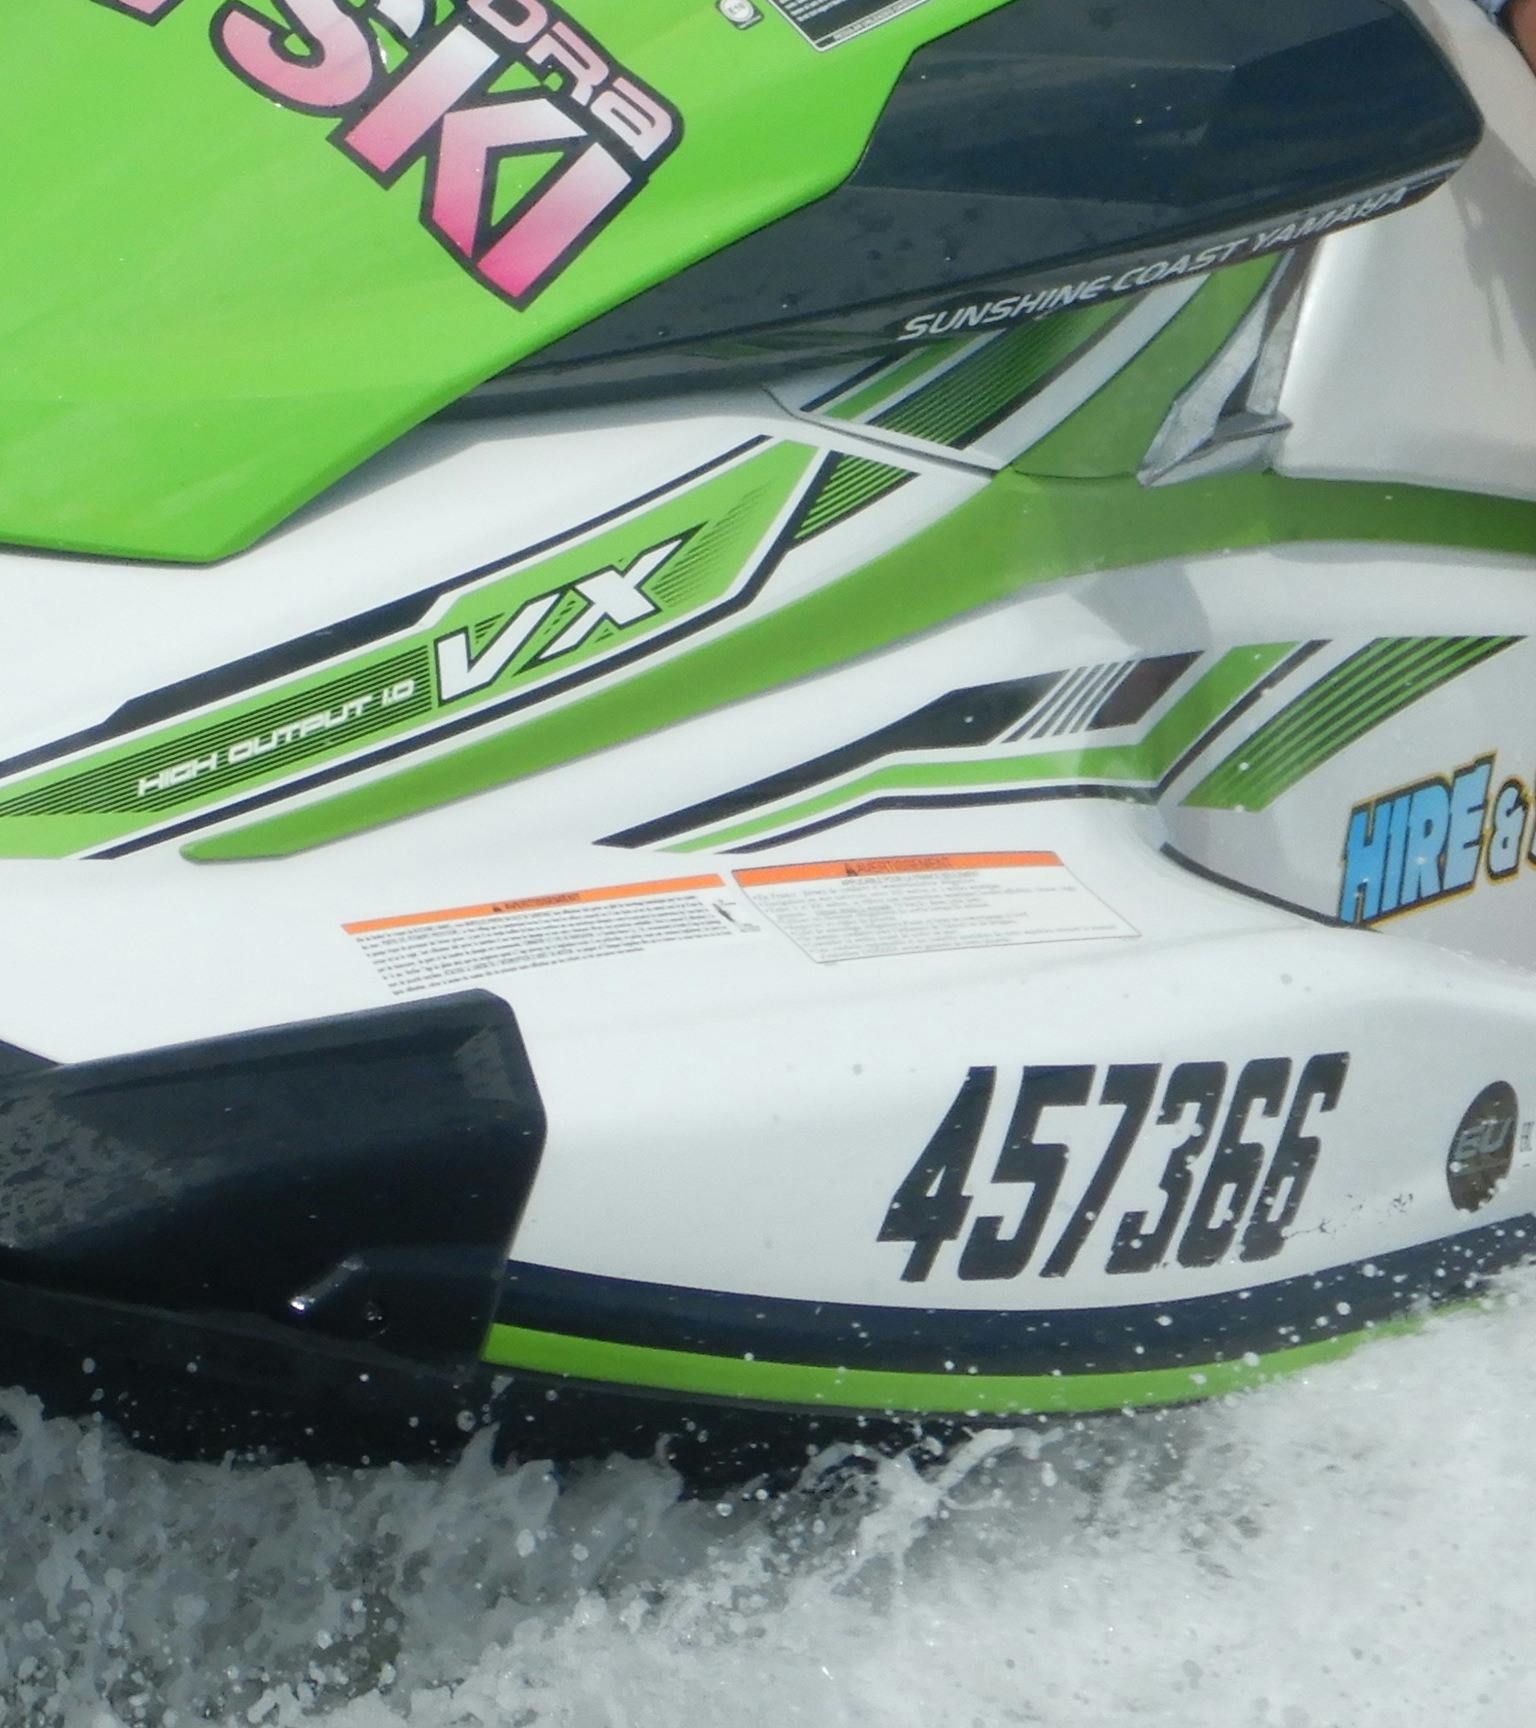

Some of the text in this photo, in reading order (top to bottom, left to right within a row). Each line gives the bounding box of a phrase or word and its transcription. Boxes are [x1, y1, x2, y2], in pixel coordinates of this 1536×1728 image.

[896, 186, 1408, 343] SUNSHINE COAST YAMAHA
[433, 520, 708, 709] VX
[137, 750, 218, 798] HIGH
[227, 692, 374, 762] OUTPUT
[1338, 755, 1495, 926] HIRE
[1484, 778, 1530, 881] &
[875, 1050, 1351, 1283] 457366
